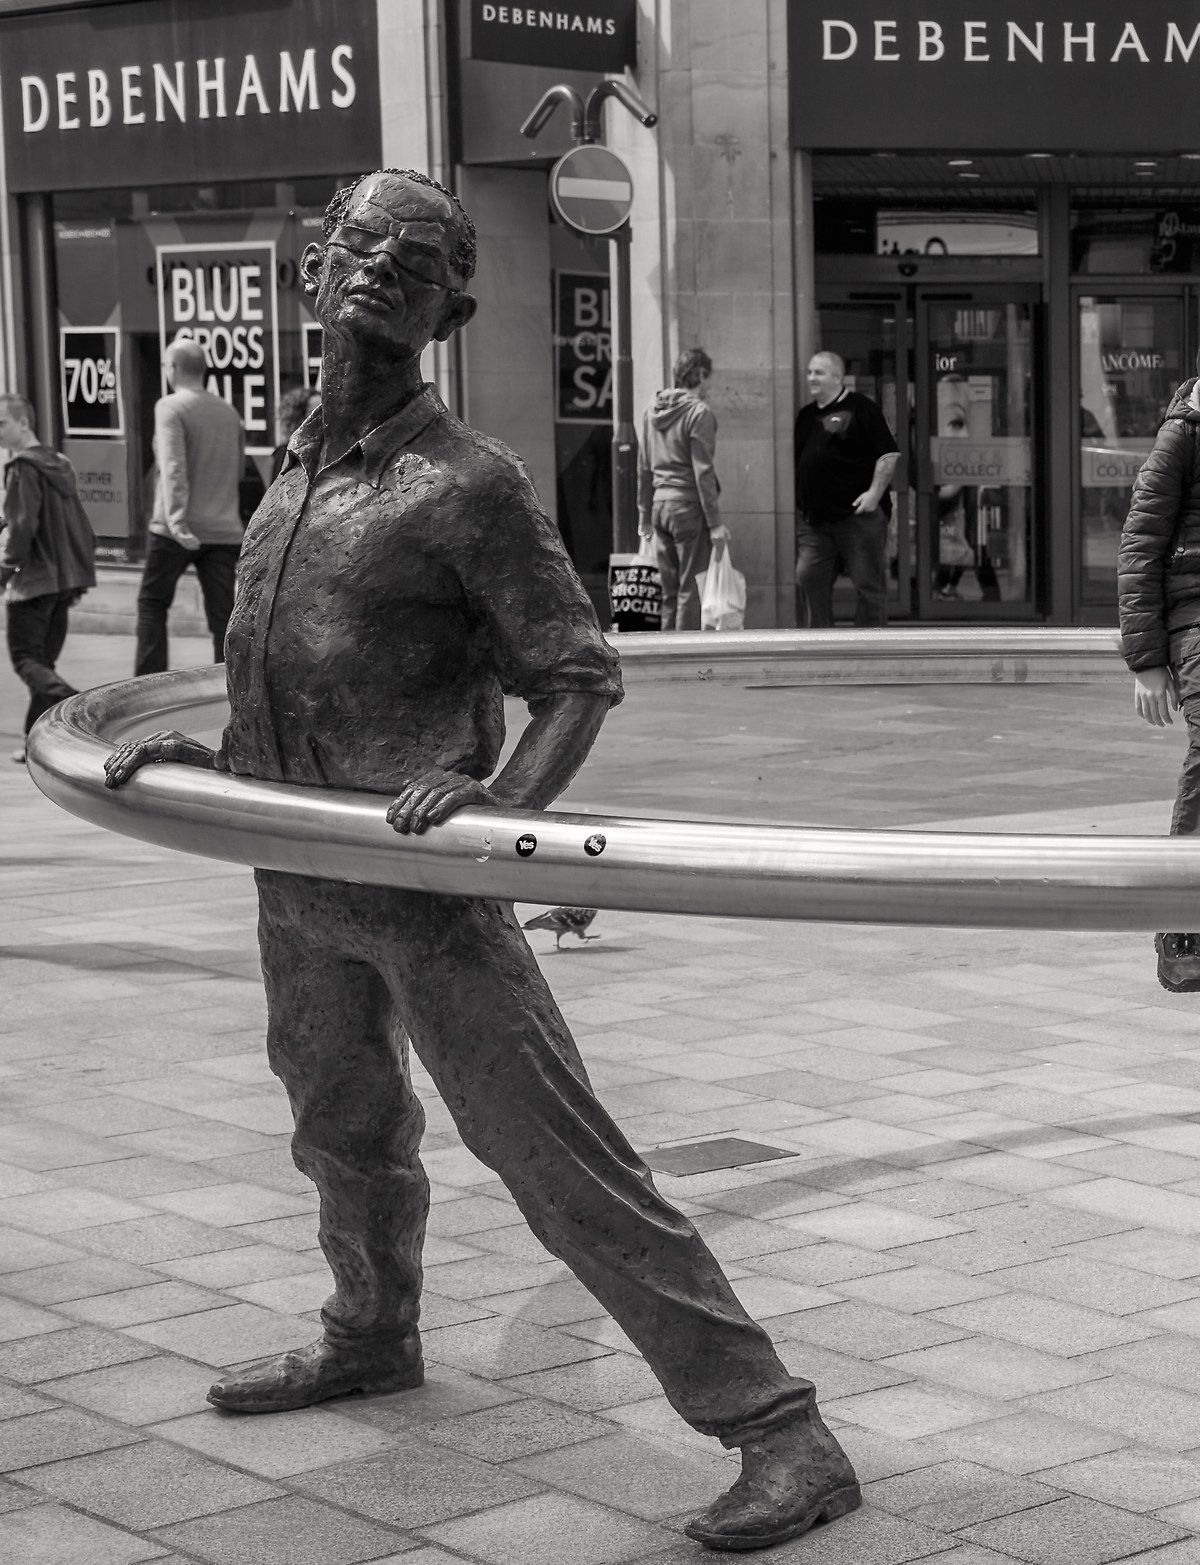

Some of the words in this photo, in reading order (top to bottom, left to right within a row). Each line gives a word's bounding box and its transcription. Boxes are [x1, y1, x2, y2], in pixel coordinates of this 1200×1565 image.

[482, 4, 616, 35] DEBENHAMS
[20, 44, 357, 133] DEBENHAMS
[172, 266, 263, 322] BLUE
[574, 287, 612, 328] BL
[174, 326, 264, 369] ROSS
[936, 353, 957, 371] ior
[64, 357, 116, 404] 70%
[944, 464, 1003, 476] COLLECT
[1097, 465, 1141, 477] COLLE
[614, 568, 639, 583] WE
[613, 598, 661, 616] LOCAL
[518, 840, 534, 850] Yes
[588, 836, 602, 853] Yes
